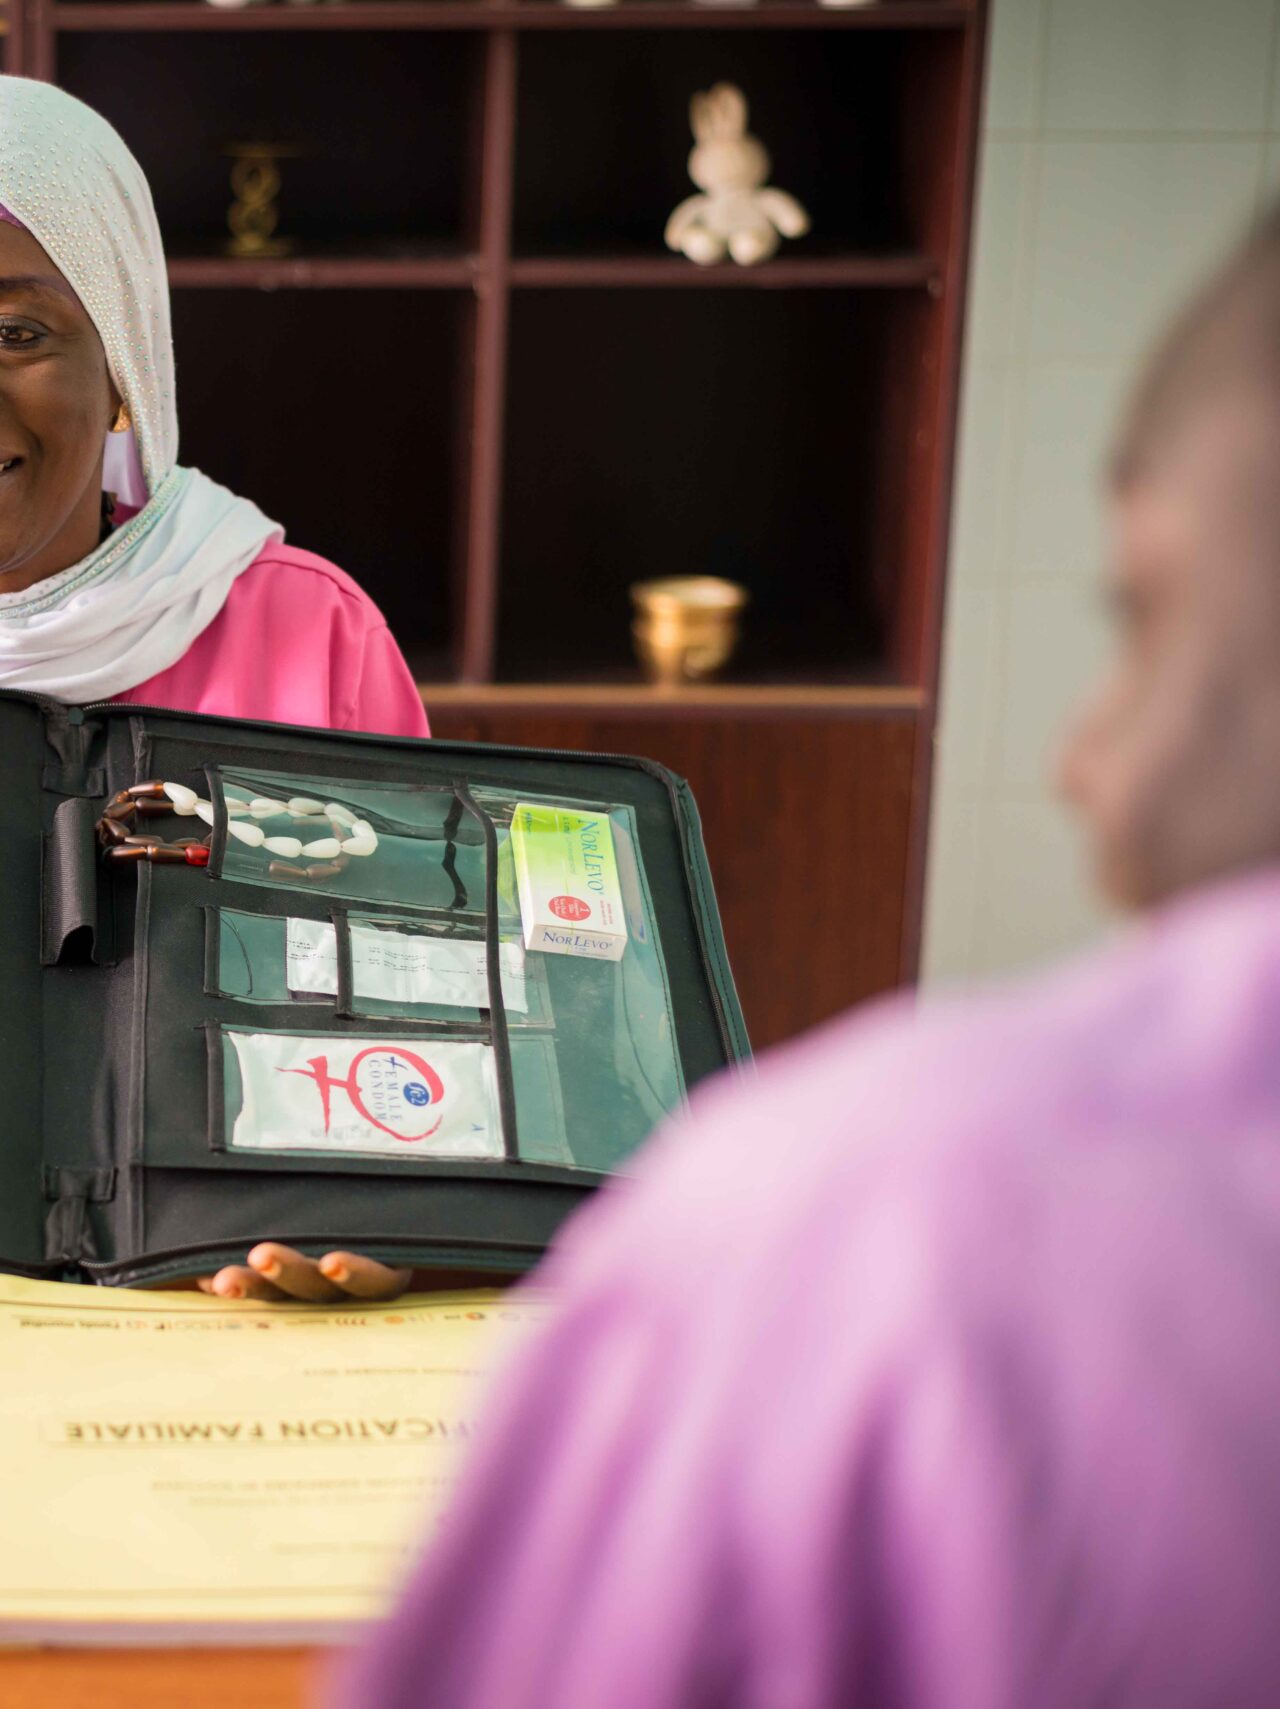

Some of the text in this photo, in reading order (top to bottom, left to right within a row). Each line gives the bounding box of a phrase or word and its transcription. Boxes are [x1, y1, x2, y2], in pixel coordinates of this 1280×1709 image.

[369, 1060, 387, 1120] CONDOM
[382, 1057, 408, 1121] FEMALE
[64, 1421, 264, 1440] FAMILIALE
